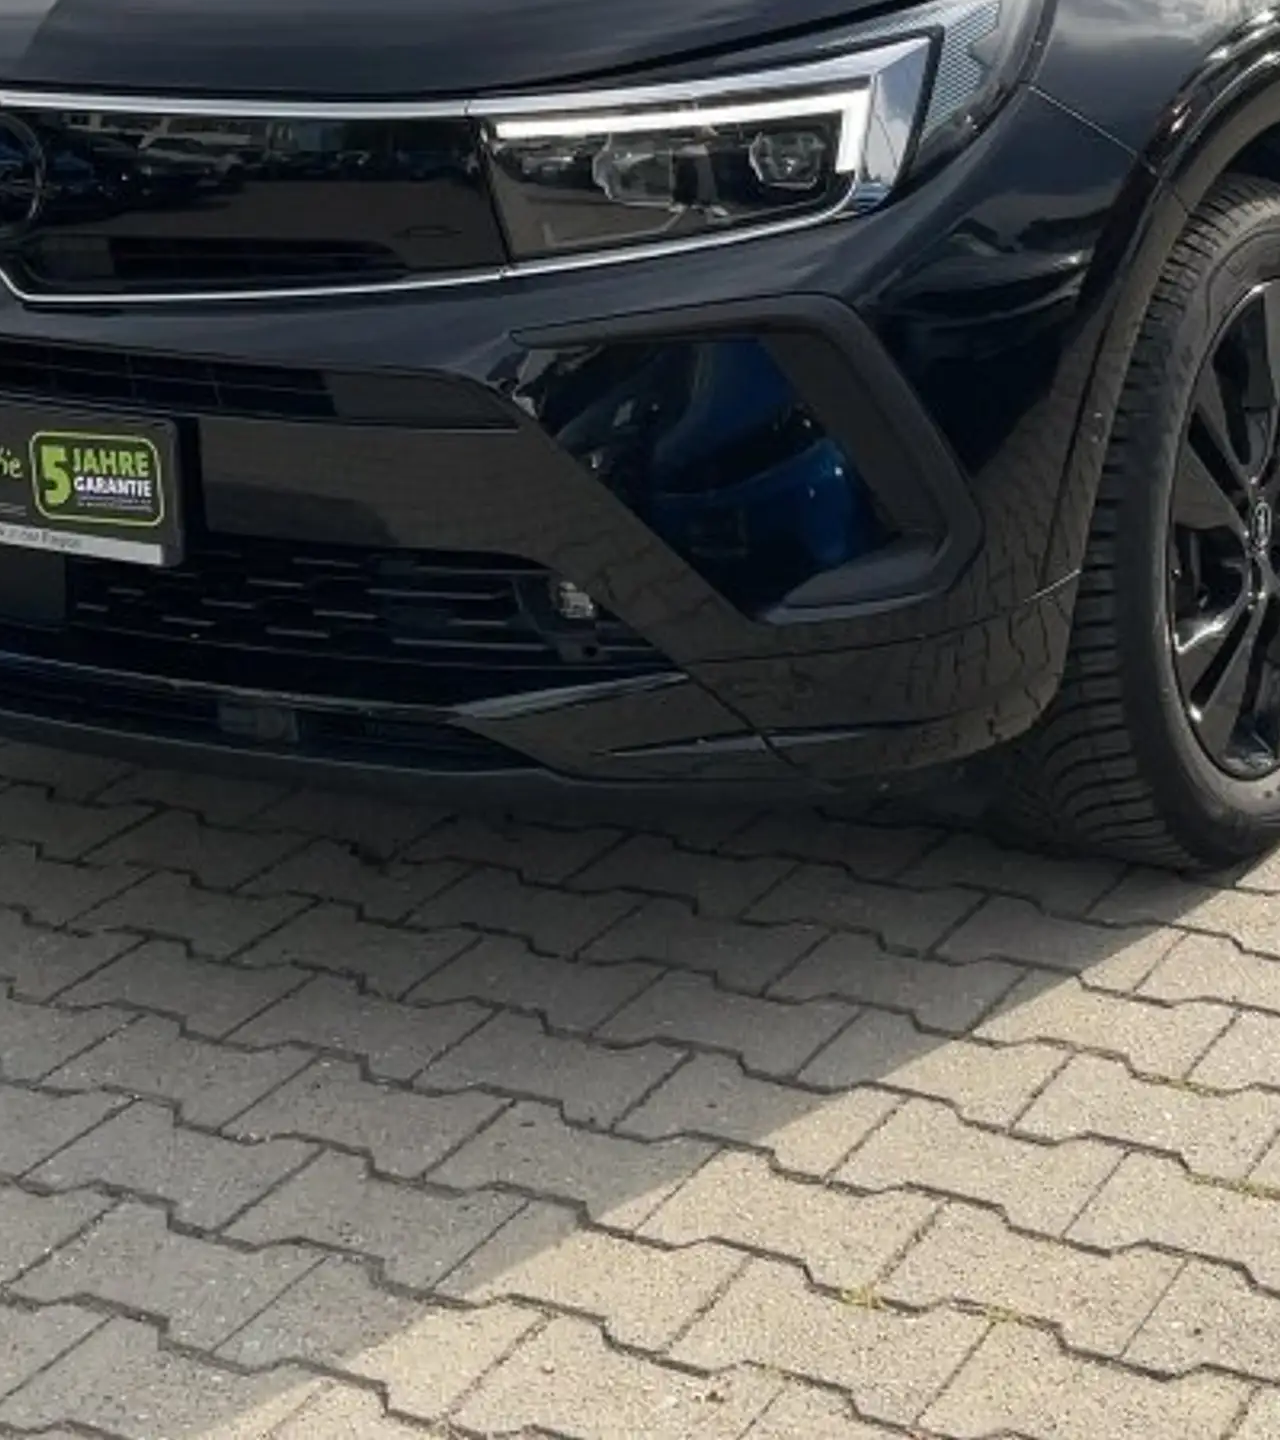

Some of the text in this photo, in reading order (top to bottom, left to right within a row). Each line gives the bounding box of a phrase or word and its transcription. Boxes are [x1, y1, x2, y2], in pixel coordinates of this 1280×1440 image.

[41, 445, 72, 506] 5
[73, 447, 150, 478] JAHRE
[74, 476, 153, 498] GARANTIE
